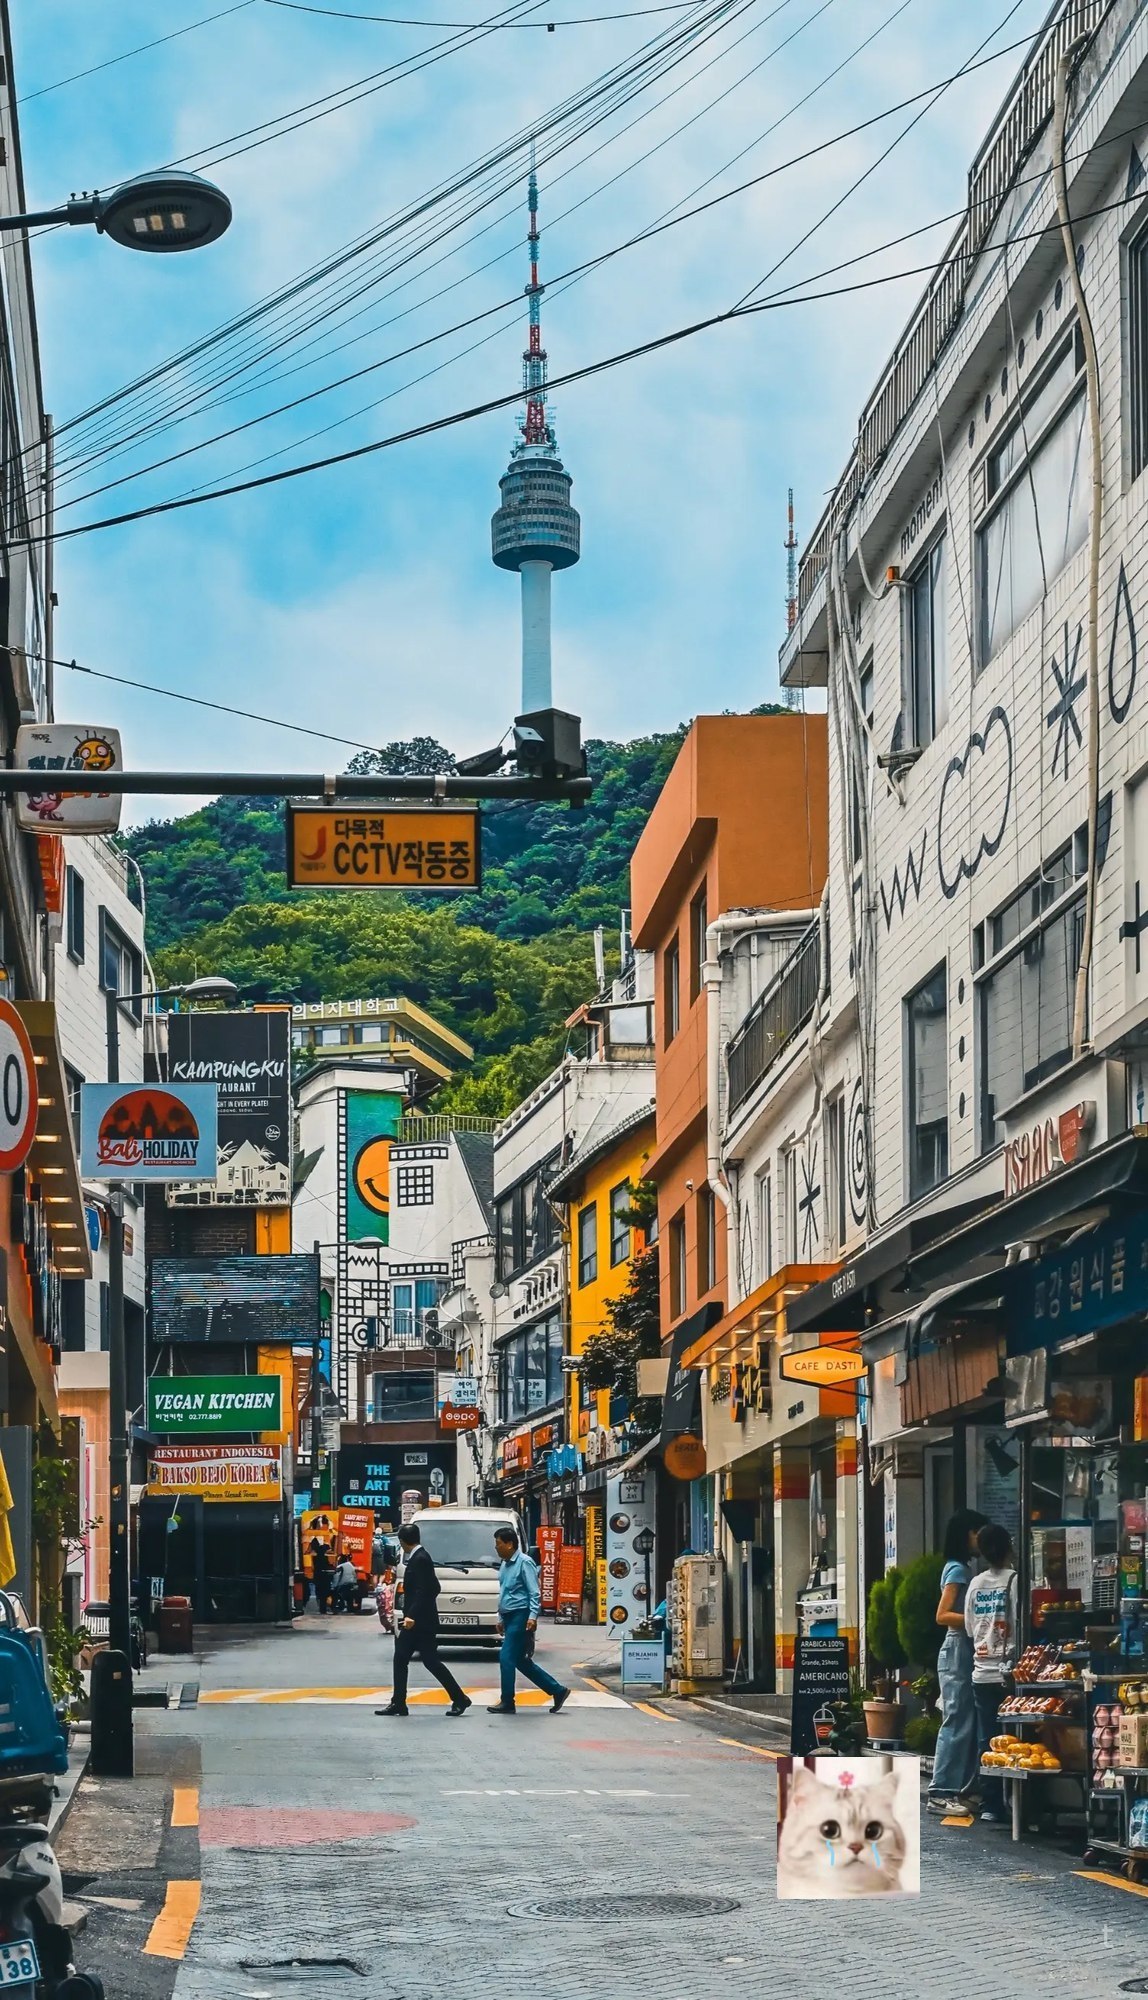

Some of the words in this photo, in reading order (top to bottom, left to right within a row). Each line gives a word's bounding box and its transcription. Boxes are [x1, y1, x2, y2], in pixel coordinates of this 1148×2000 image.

[901, 464, 943, 560] moment
[334, 819, 384, 840] 다목적
[173, 1060, 286, 1079] KAMPUNGKU
[97, 1136, 143, 1163] Bali
[144, 1141, 199, 1159] HOLIDAY
[794, 1362, 820, 1371] CAFE
[826, 1361, 857, 1371] D'ASTI
[155, 1394, 205, 1410] VEGAN
[208, 1393, 275, 1409] KITCHEN
[154, 1448, 219, 1459] RESTAURANT
[221, 1447, 274, 1458] INDONESIA
[162, 1466, 198, 1485] BAKSO
[200, 1464, 228, 1485] BEJO
[230, 1463, 267, 1484] KOREA
[365, 1464, 390, 1475] THE
[364, 1480, 390, 1491] ART
[342, 1495, 390, 1507] CENTER
[976, 1591, 993, 1603] Good
[800, 1672, 849, 1681] AMERICANO
